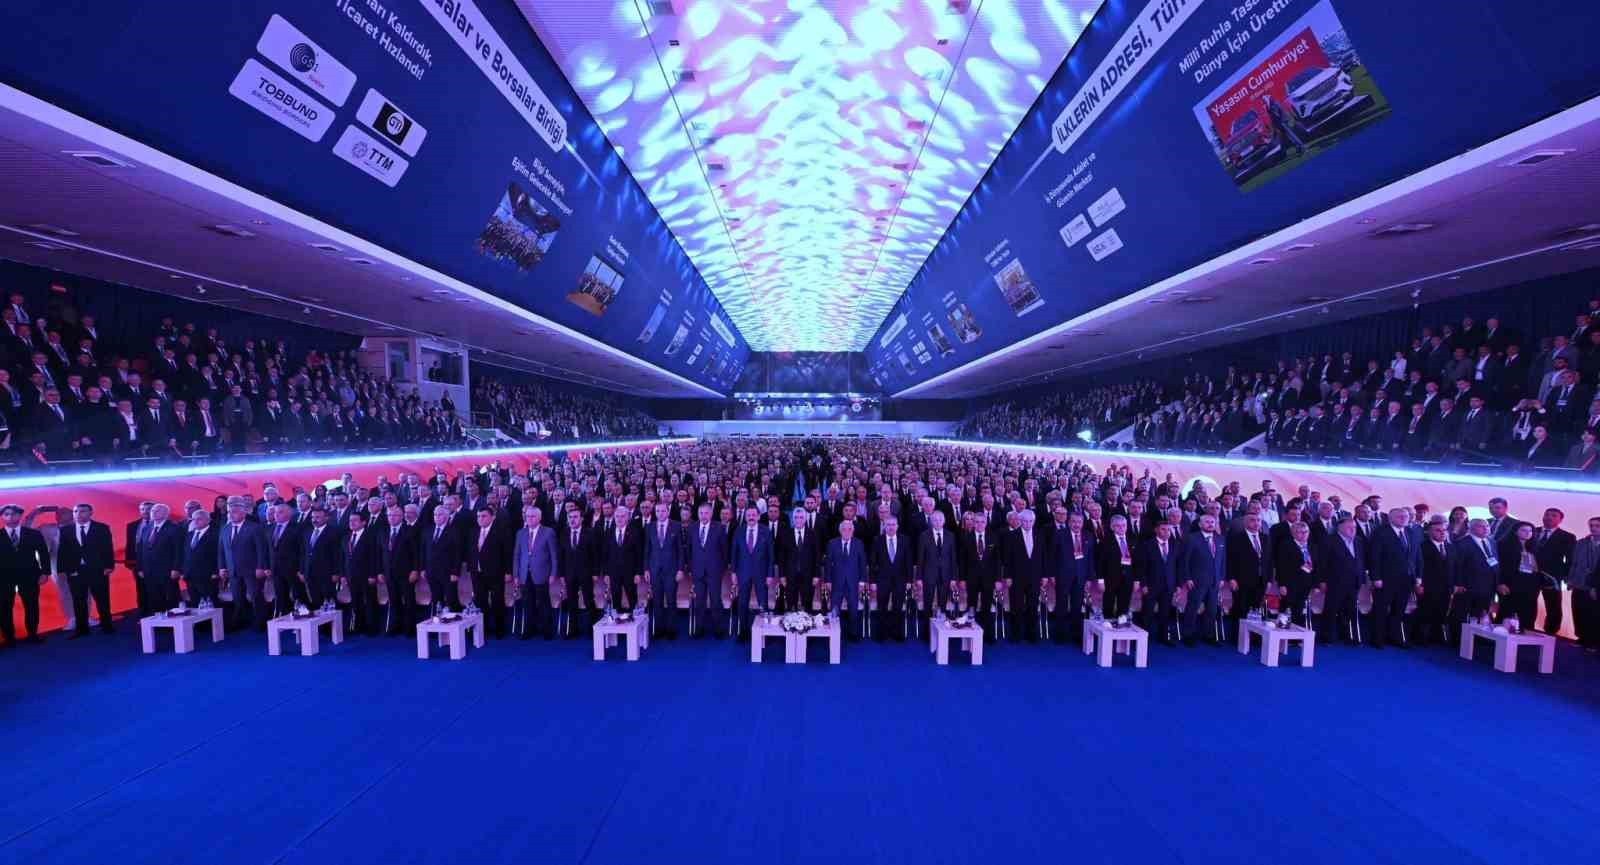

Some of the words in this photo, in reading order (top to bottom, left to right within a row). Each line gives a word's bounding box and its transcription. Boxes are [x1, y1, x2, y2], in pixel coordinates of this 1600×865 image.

[302, 55, 319, 73] GS1
[379, 32, 425, 81] Hızlandı!
[387, 12, 432, 67] Kaldırdık,
[1179, 47, 1201, 74] Milli
[1200, 20, 1232, 54] Ruhla
[475, 32, 491, 60] ve
[491, 50, 536, 112] Borsalar
[536, 104, 563, 144] Birliği
[1055, 86, 1100, 144] İLKLERİN
[1100, 25, 1153, 96] ADRESİ,
[1194, 50, 1229, 84] Dünya
[1211, 86, 1249, 117] Yaşasın
[1248, 38, 1310, 90] Cumhuriyet
[258, 77, 318, 121] TOBBUND
[369, 147, 394, 171] TTM
